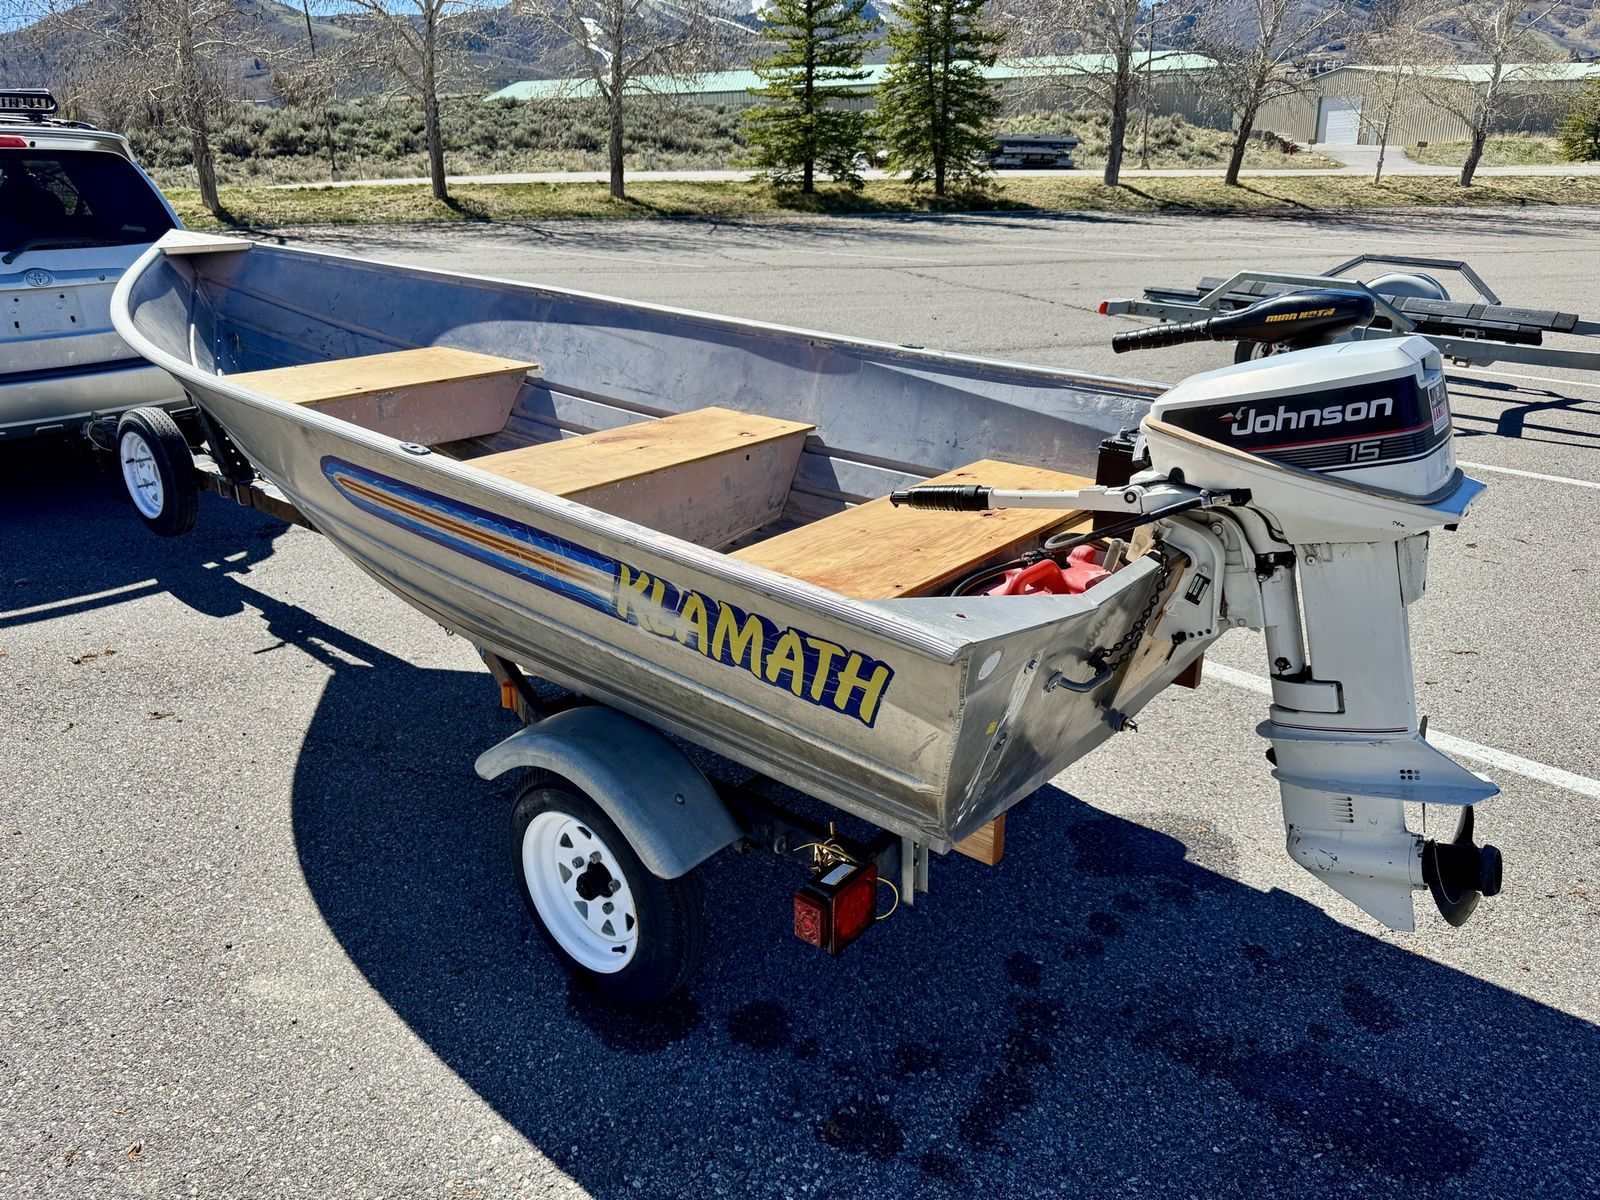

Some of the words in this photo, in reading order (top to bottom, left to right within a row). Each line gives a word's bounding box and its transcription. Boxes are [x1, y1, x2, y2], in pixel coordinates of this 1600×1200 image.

[1230, 397, 1393, 436] Johnson
[1350, 440, 1381, 462] 15
[616, 562, 891, 726] KLAMATH
